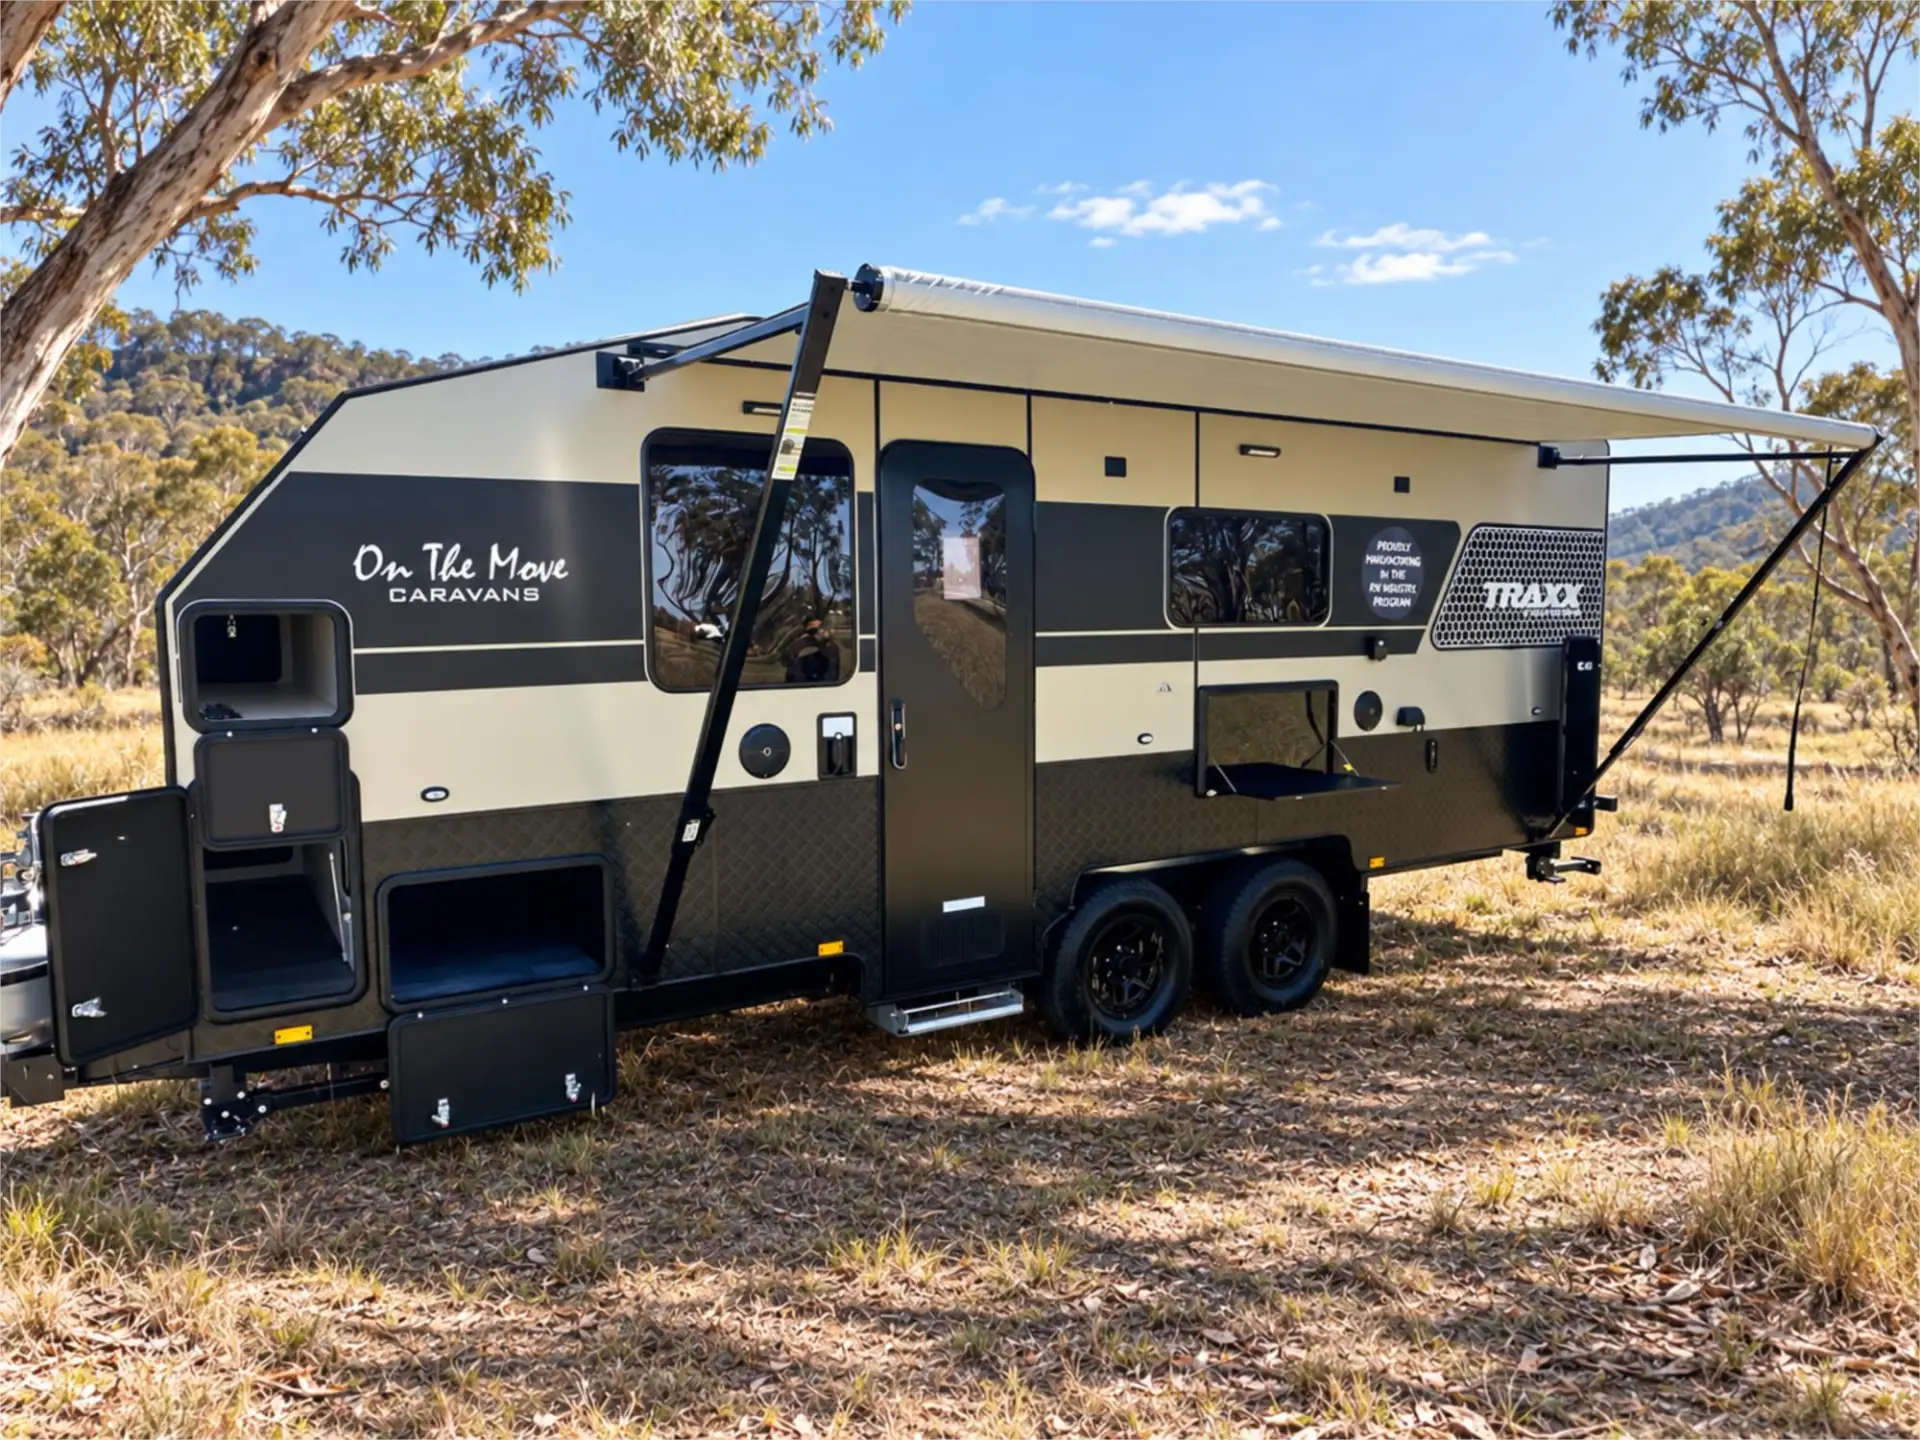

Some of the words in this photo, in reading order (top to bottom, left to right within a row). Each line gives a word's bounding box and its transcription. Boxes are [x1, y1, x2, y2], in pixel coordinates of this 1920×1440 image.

[353, 543, 413, 581] On
[422, 542, 476, 582] The
[488, 543, 569, 583] Move
[389, 588, 540, 602] CARAVANS
[1484, 582, 1584, 608] TRAXX
